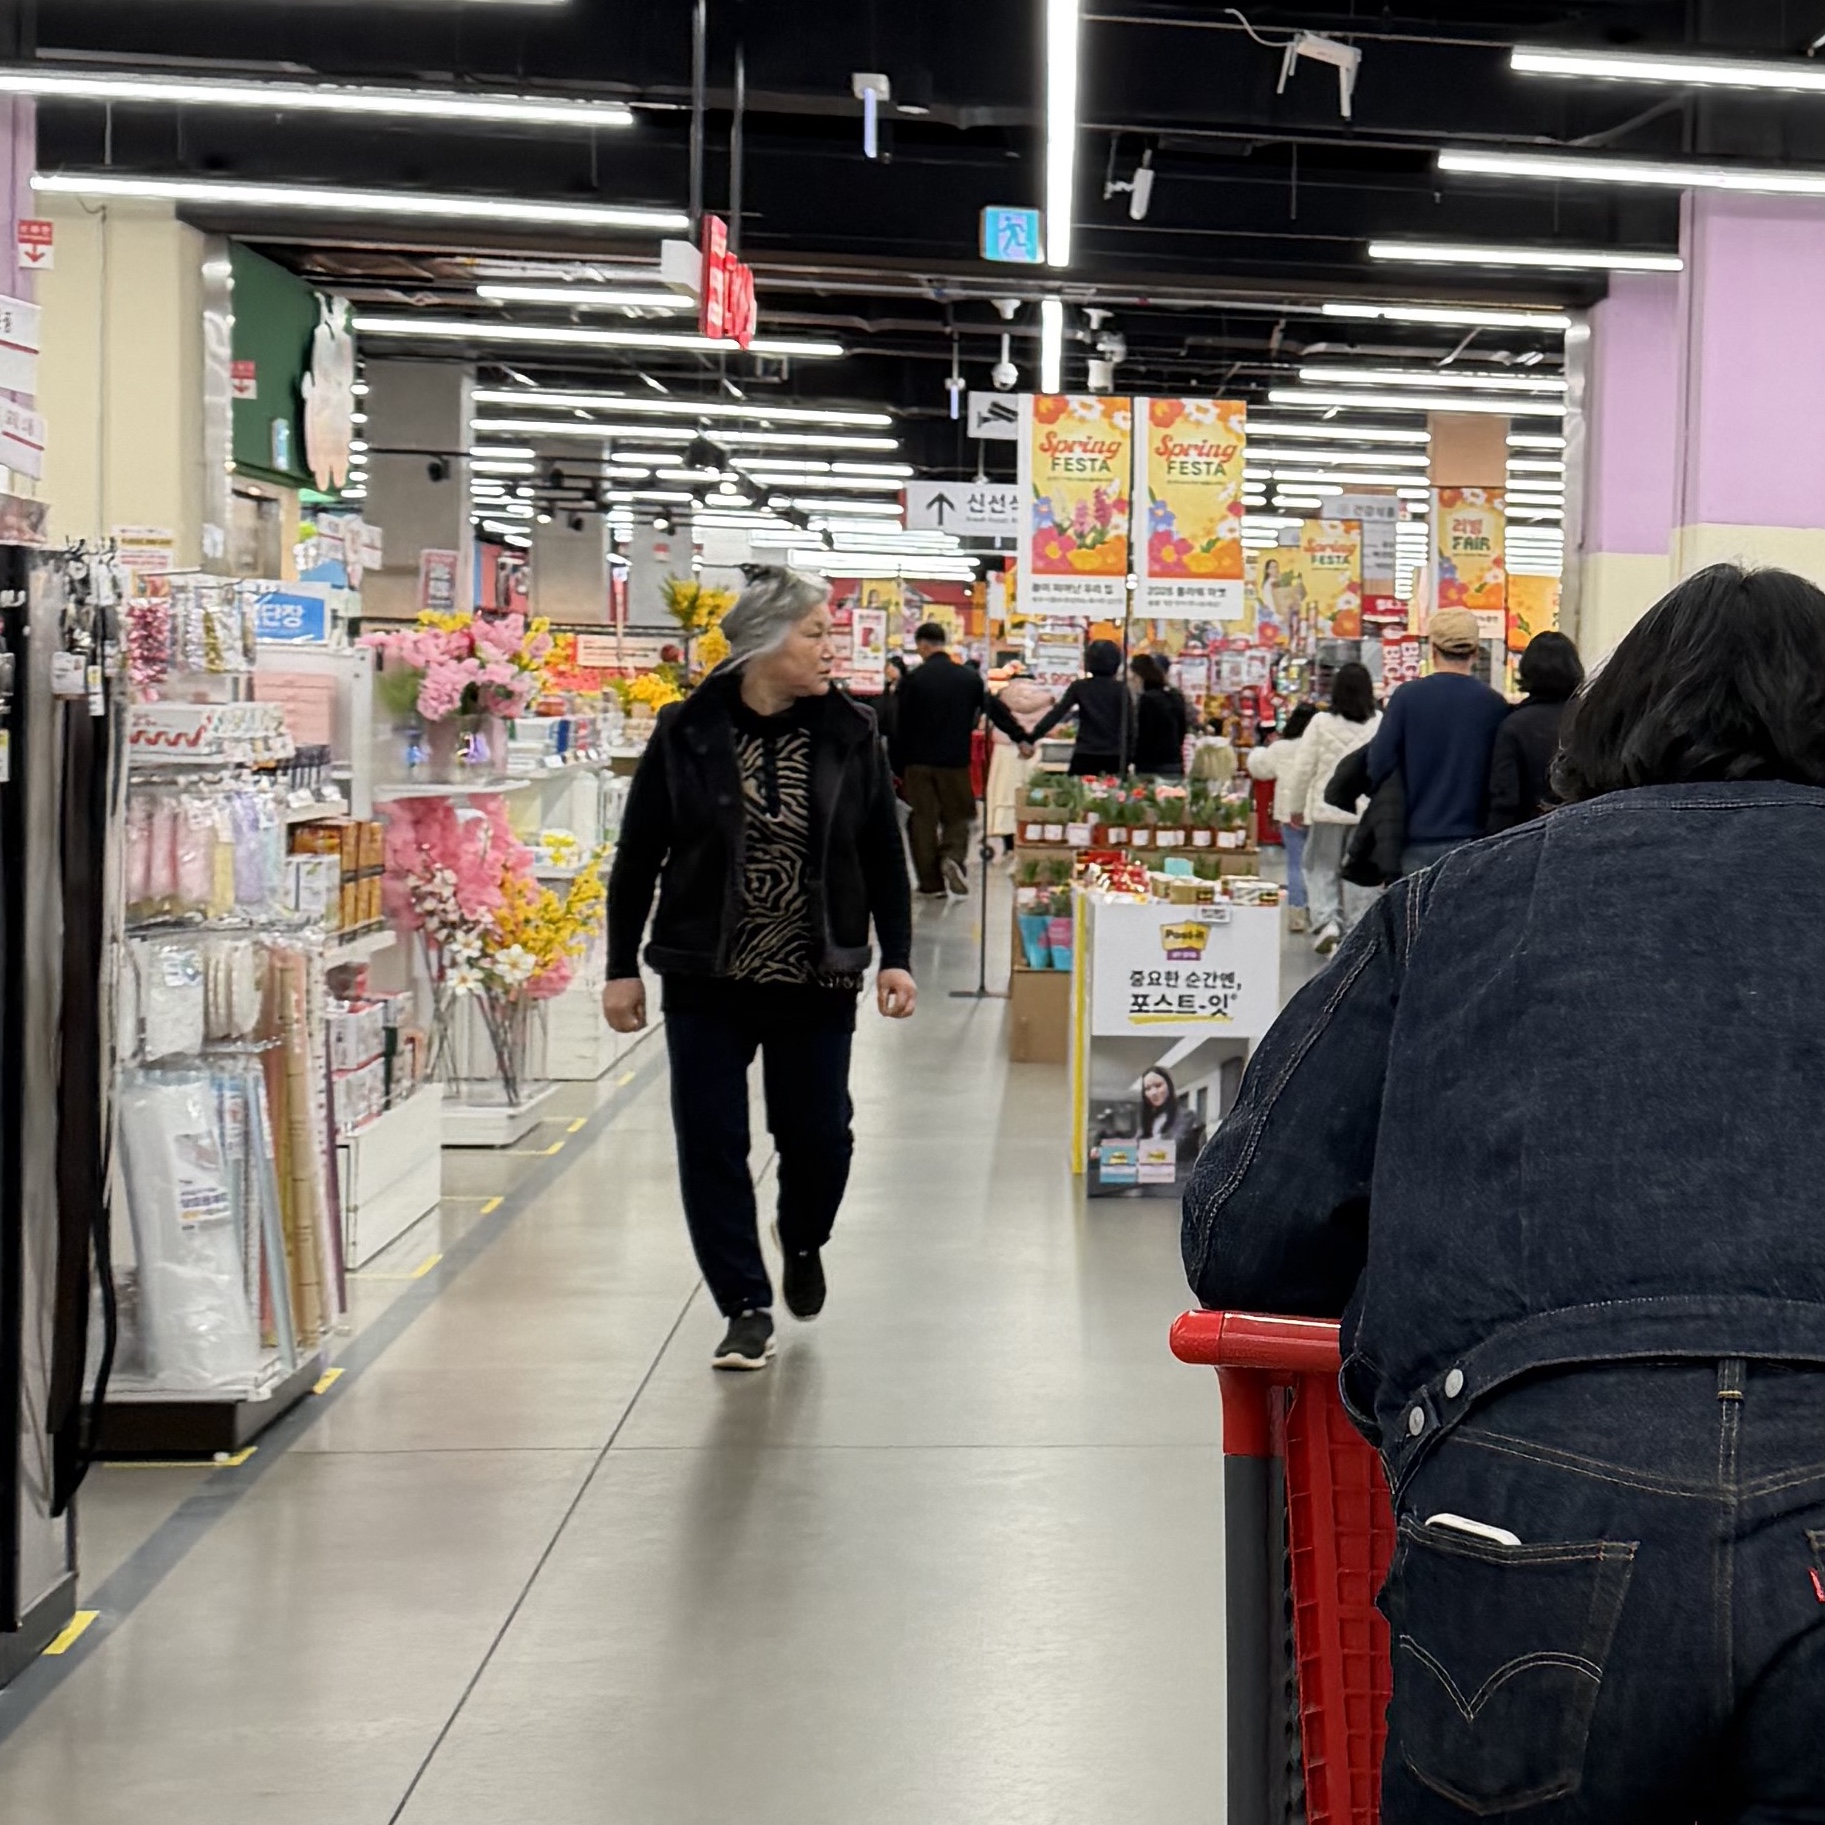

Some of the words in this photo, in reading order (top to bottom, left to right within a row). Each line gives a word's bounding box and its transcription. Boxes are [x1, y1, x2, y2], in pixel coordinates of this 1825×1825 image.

[1039, 431, 1122, 460] Spring
[1155, 434, 1238, 463] Spring
[1051, 457, 1112, 472] FESTA
[1166, 461, 1227, 476] FESTA
[1452, 536, 1491, 551] FAIR
[1311, 554, 1350, 566] FESTA
[1165, 929, 1205, 940] Post-it
[1129, 970, 1179, 988] 중요한
[1186, 970, 1242, 991] 순간엔,
